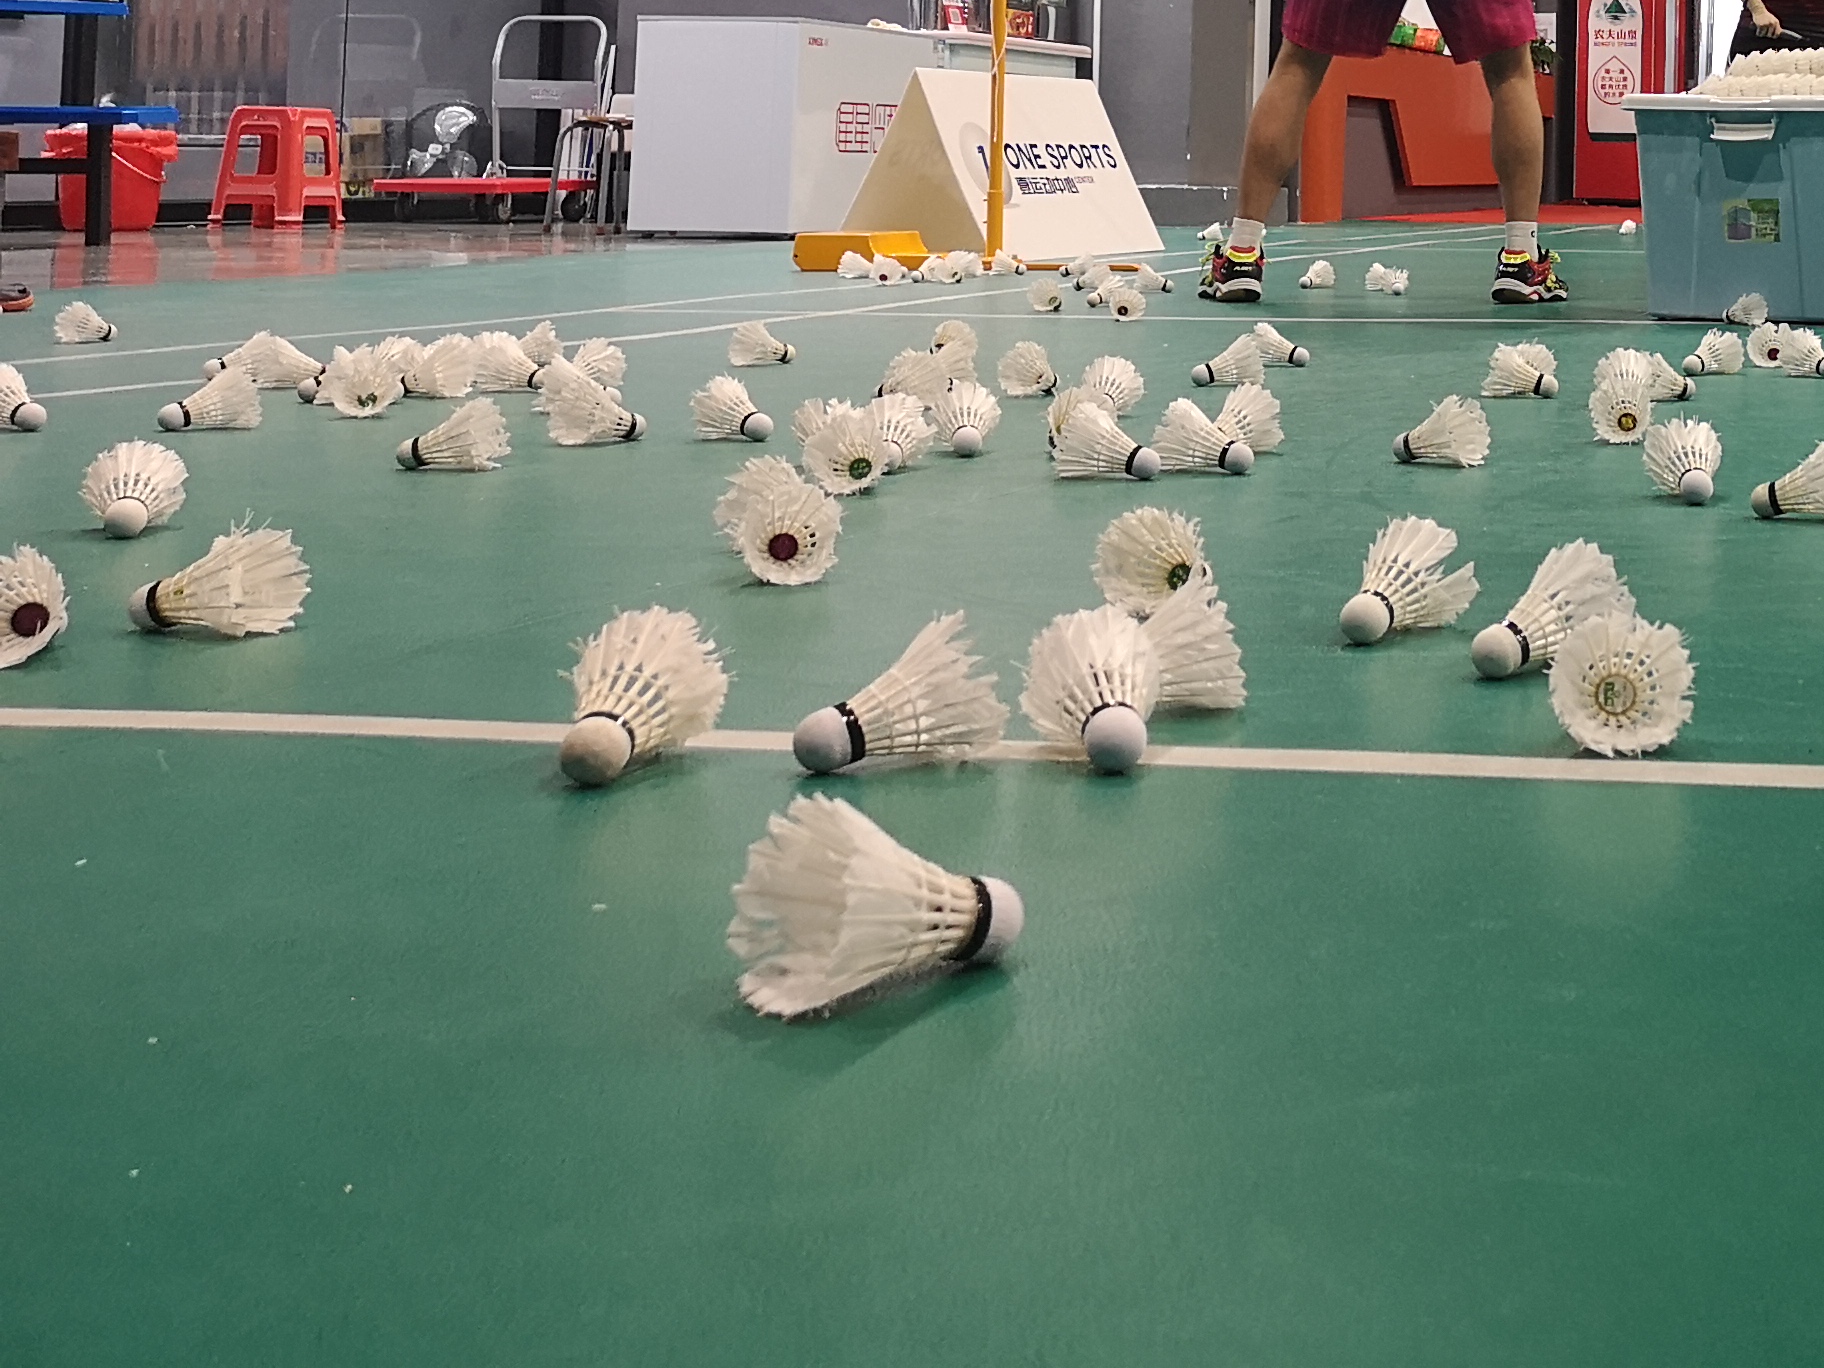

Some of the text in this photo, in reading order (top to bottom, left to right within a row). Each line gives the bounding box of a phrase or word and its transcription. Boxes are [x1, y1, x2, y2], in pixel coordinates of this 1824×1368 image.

[1593, 29, 1638, 41] 农夫山泉
[1003, 143, 1117, 170] ONE SPORTS
